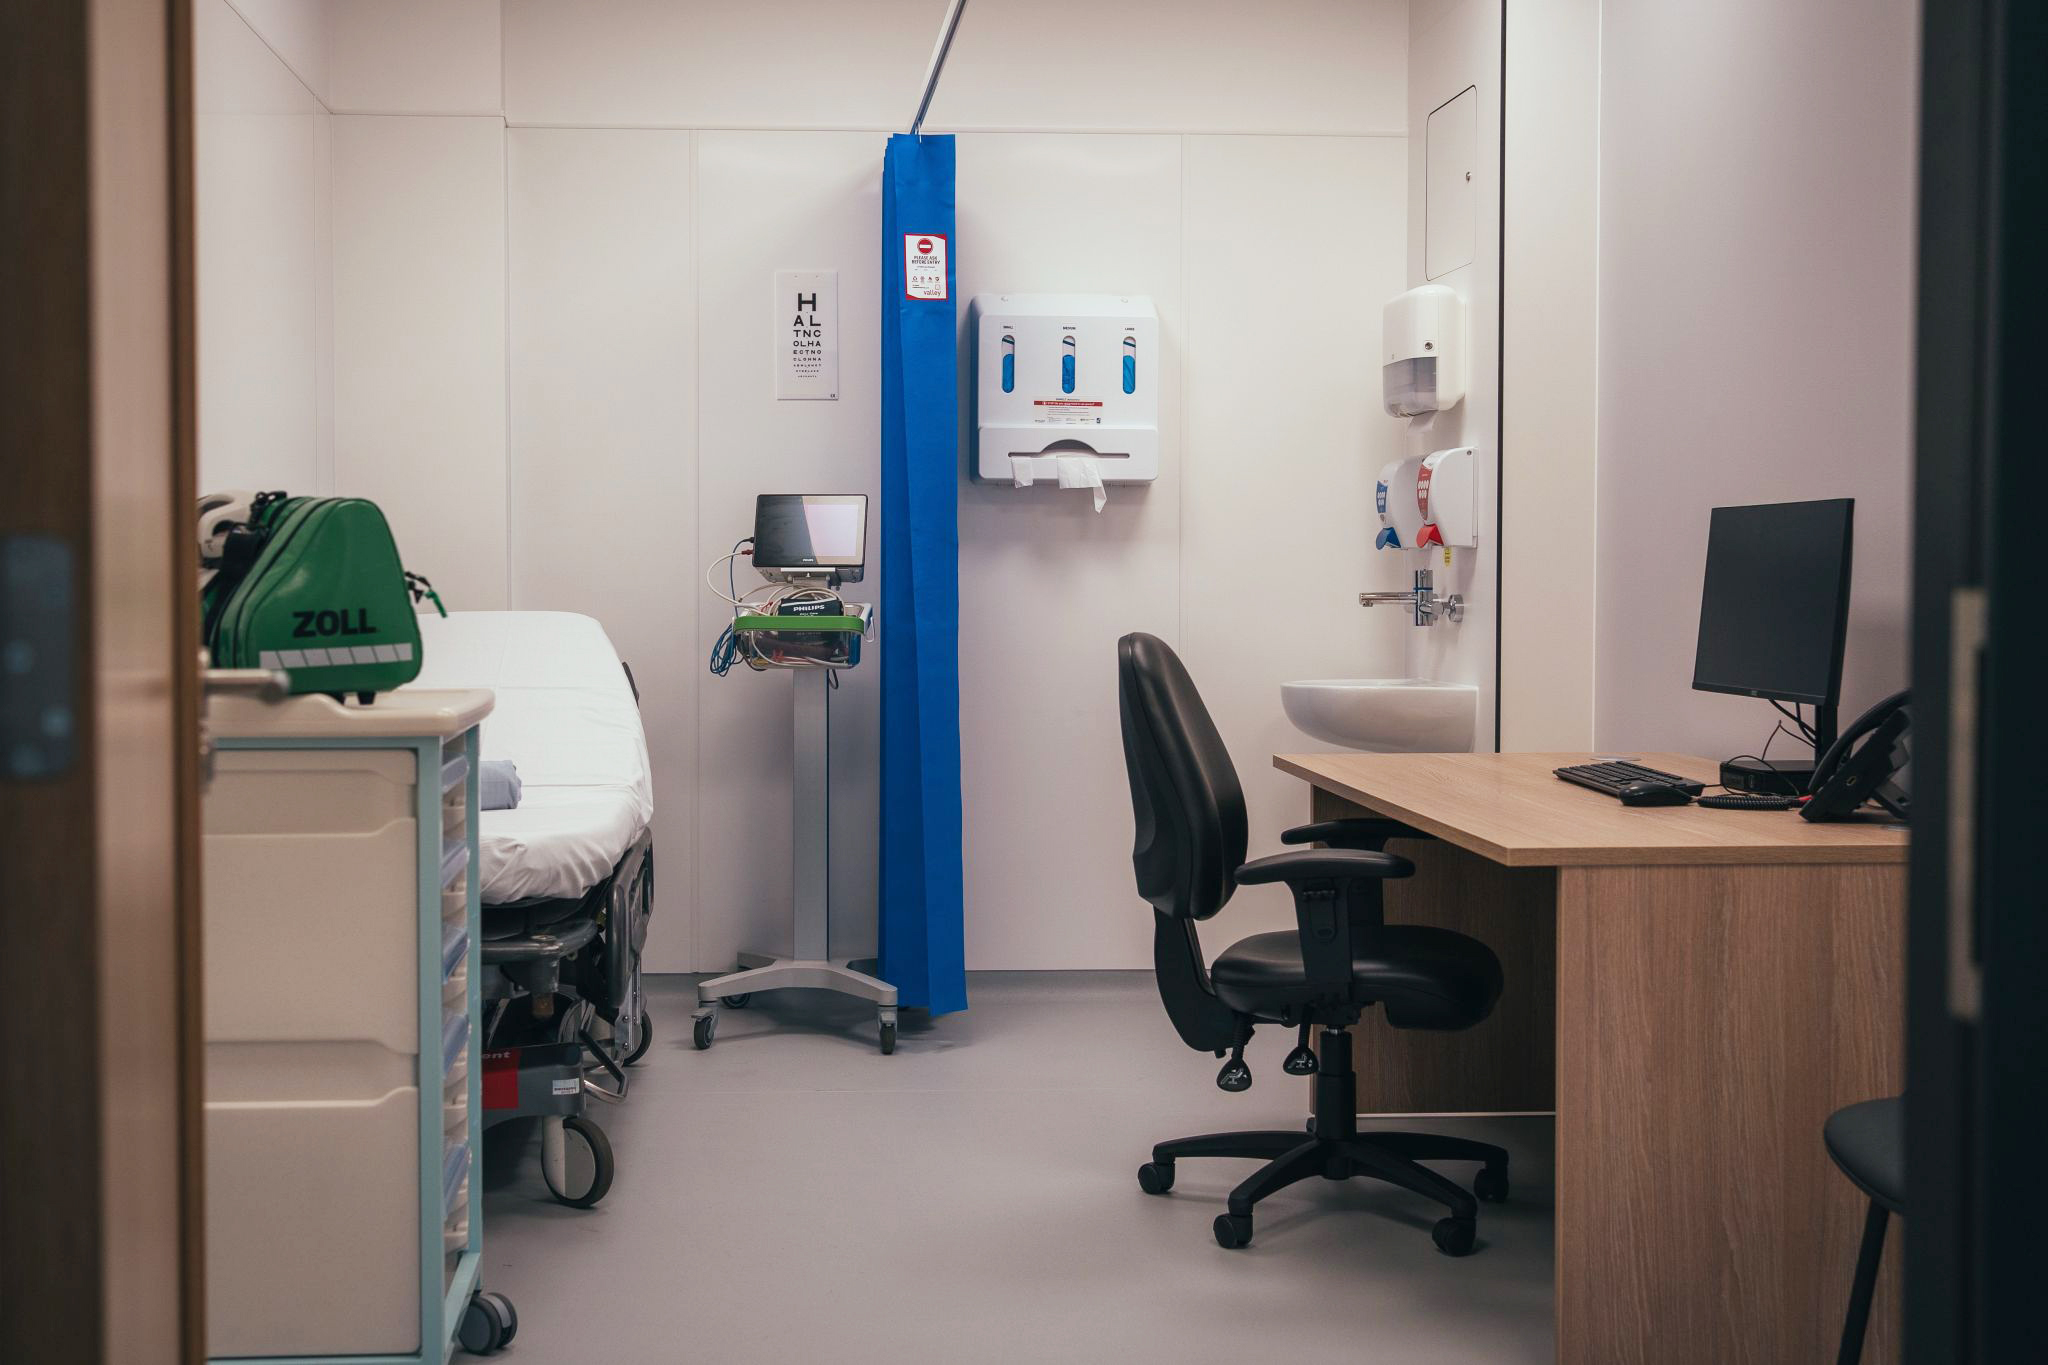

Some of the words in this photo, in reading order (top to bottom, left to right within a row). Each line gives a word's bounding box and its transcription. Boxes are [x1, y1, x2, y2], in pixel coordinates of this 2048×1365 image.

[797, 292, 817, 312] H
[793, 314, 822, 327] AL
[793, 329, 822, 338] TNC
[793, 340, 822, 348] OLHA
[793, 604, 825, 612] PHILIPS
[292, 608, 377, 638] ZOLL
